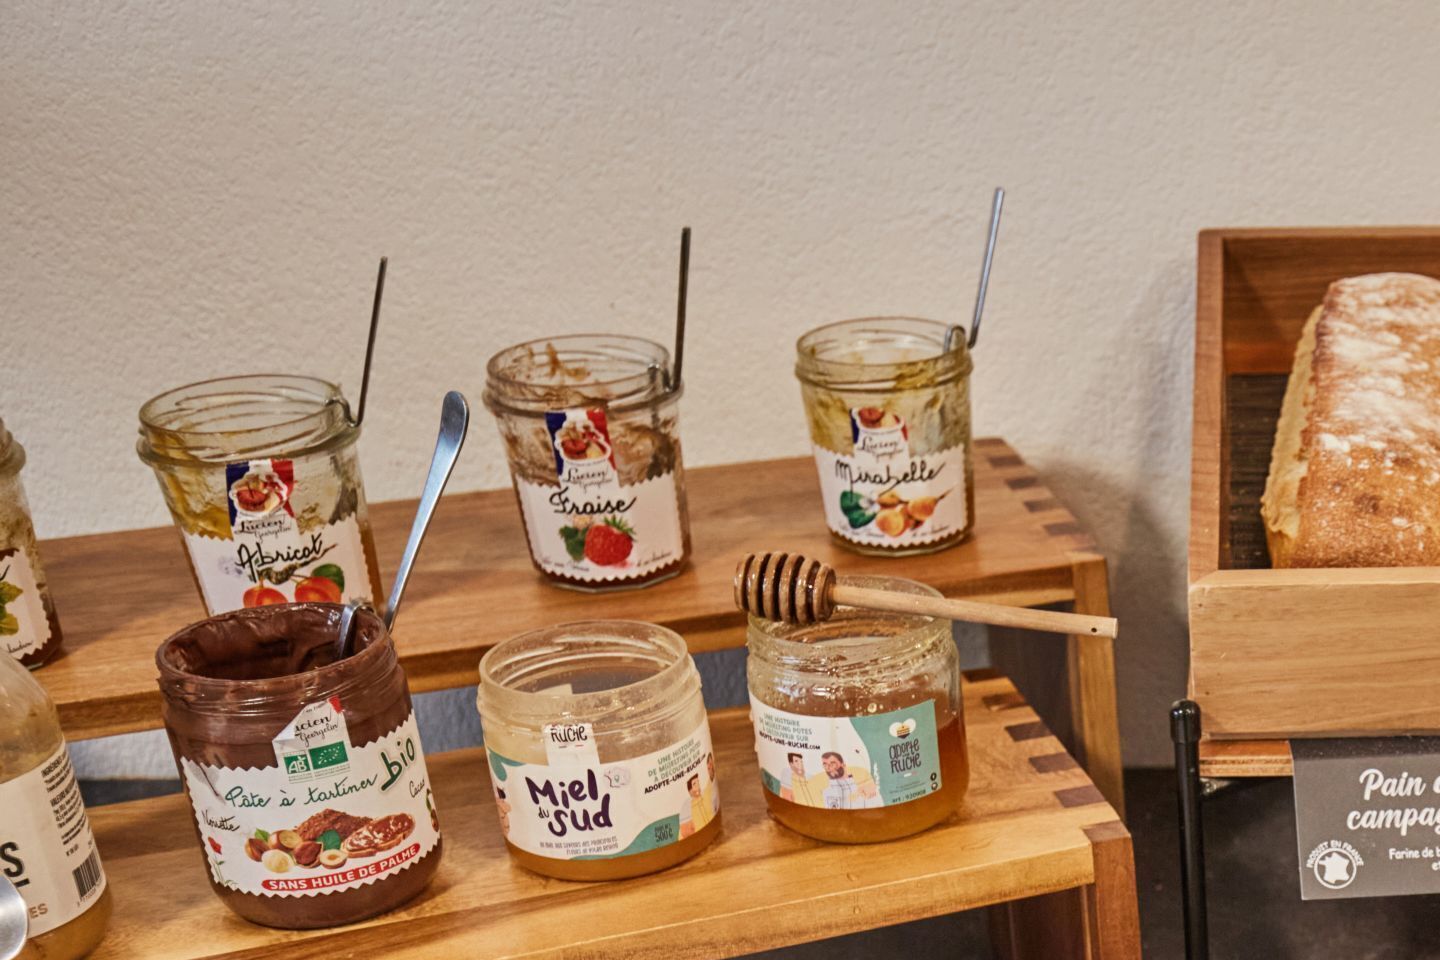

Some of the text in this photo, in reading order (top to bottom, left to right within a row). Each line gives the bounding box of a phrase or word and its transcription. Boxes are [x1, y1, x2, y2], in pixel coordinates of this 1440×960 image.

[835, 459, 946, 500] Mirabelle
[549, 486, 637, 515] Fraise
[235, 532, 323, 583] Abricot
[224, 786, 271, 807] Pâte
[279, 789, 296, 806] à
[303, 774, 378, 804] tartiner
[380, 737, 415, 791] bio
[525, 768, 598, 809] Miel
[1359, 768, 1427, 801] Pain
[538, 806, 550, 819] du
[547, 793, 613, 837] Sud
[269, 845, 416, 890] SANS HUILE DE PALME
[1388, 848, 1420, 860] Farine
[1421, 846, 1435, 858] de
